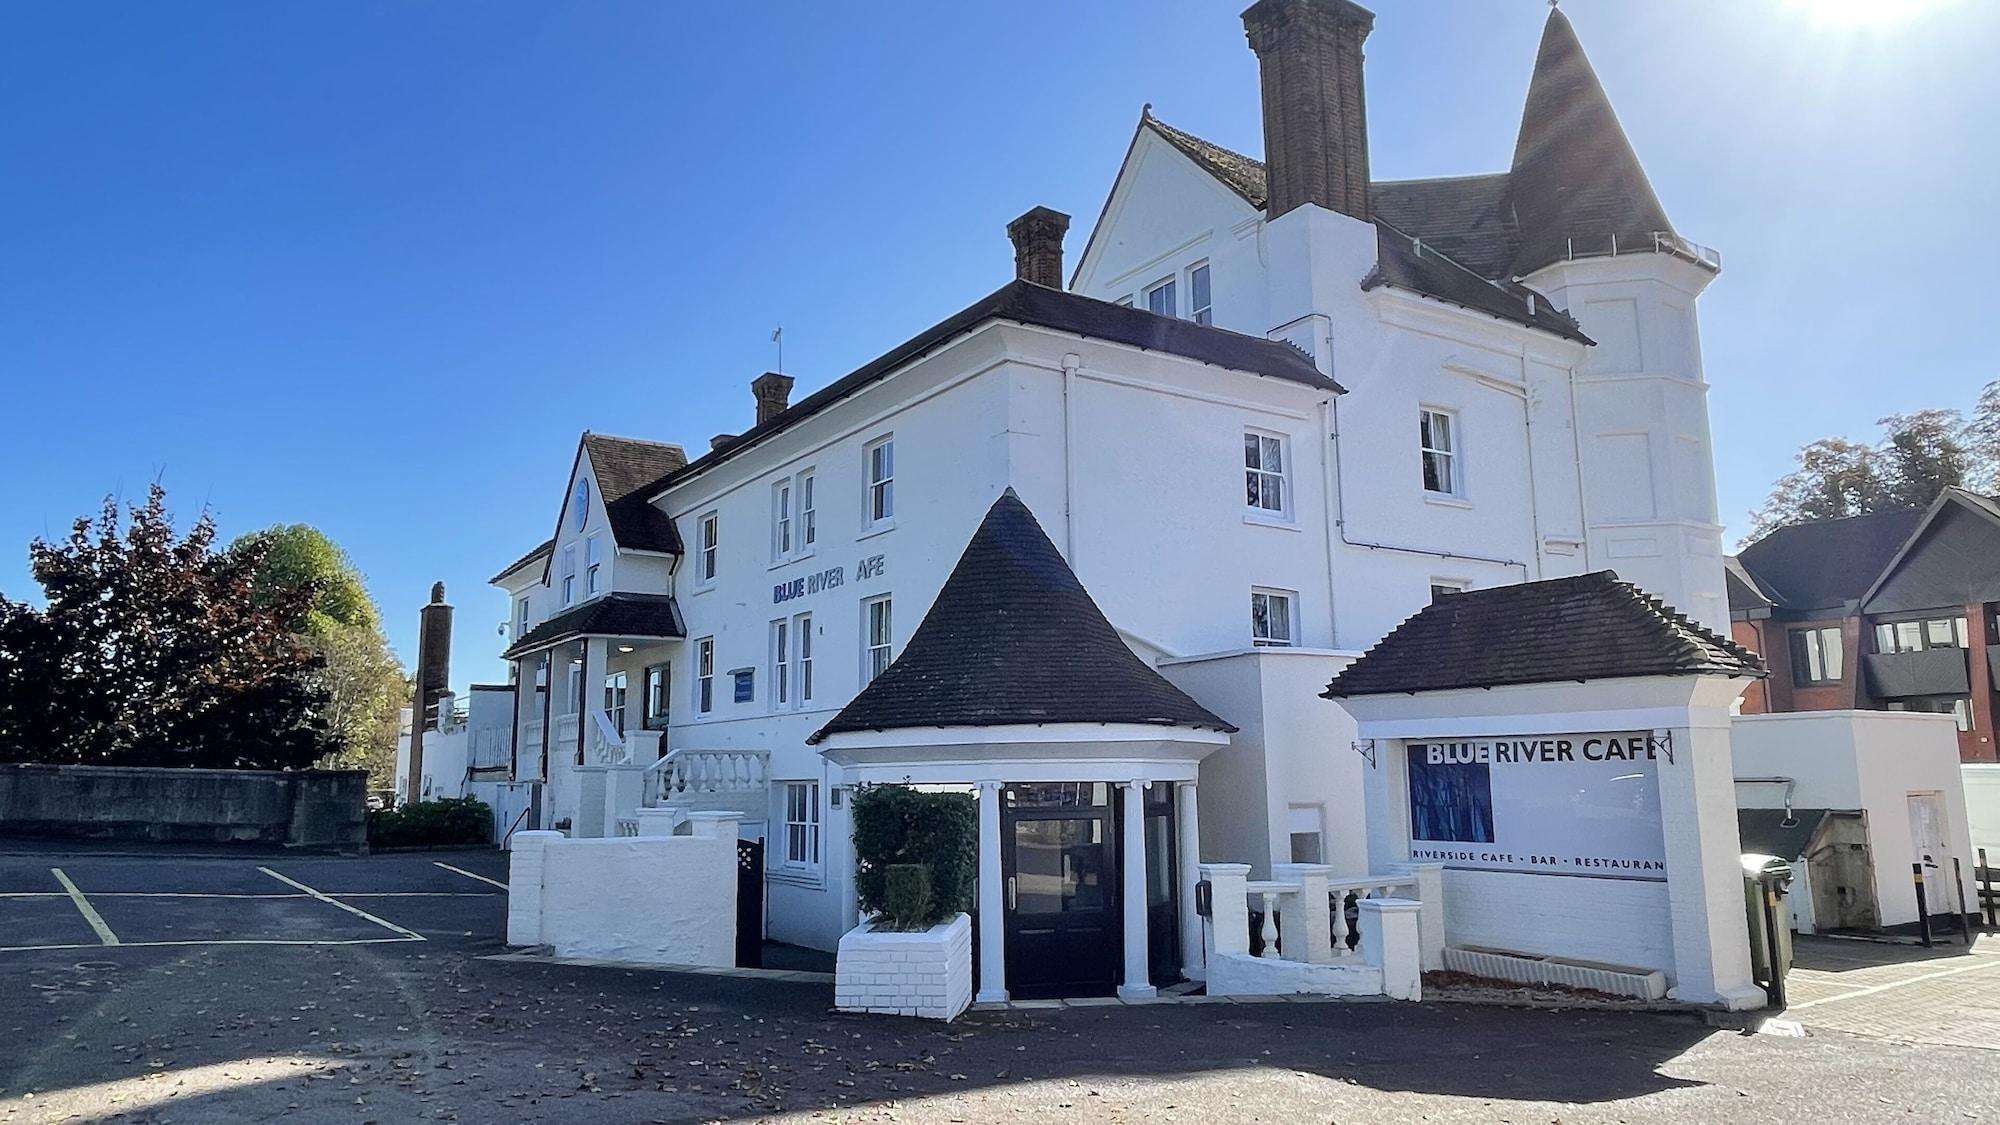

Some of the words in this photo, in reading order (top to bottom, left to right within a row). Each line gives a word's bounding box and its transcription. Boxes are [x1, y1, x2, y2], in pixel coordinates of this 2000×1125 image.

[774, 578, 804, 604] BLUE
[807, 566, 844, 595] RIVER
[1426, 743, 1489, 765] BLUE
[1496, 739, 1575, 763] RIVER
[1413, 849, 1475, 861] RIVERSIDE
[1481, 853, 1513, 863] CAFE
[1531, 855, 1557, 865] BAR
[1575, 857, 1664, 871] RESTAURAN
